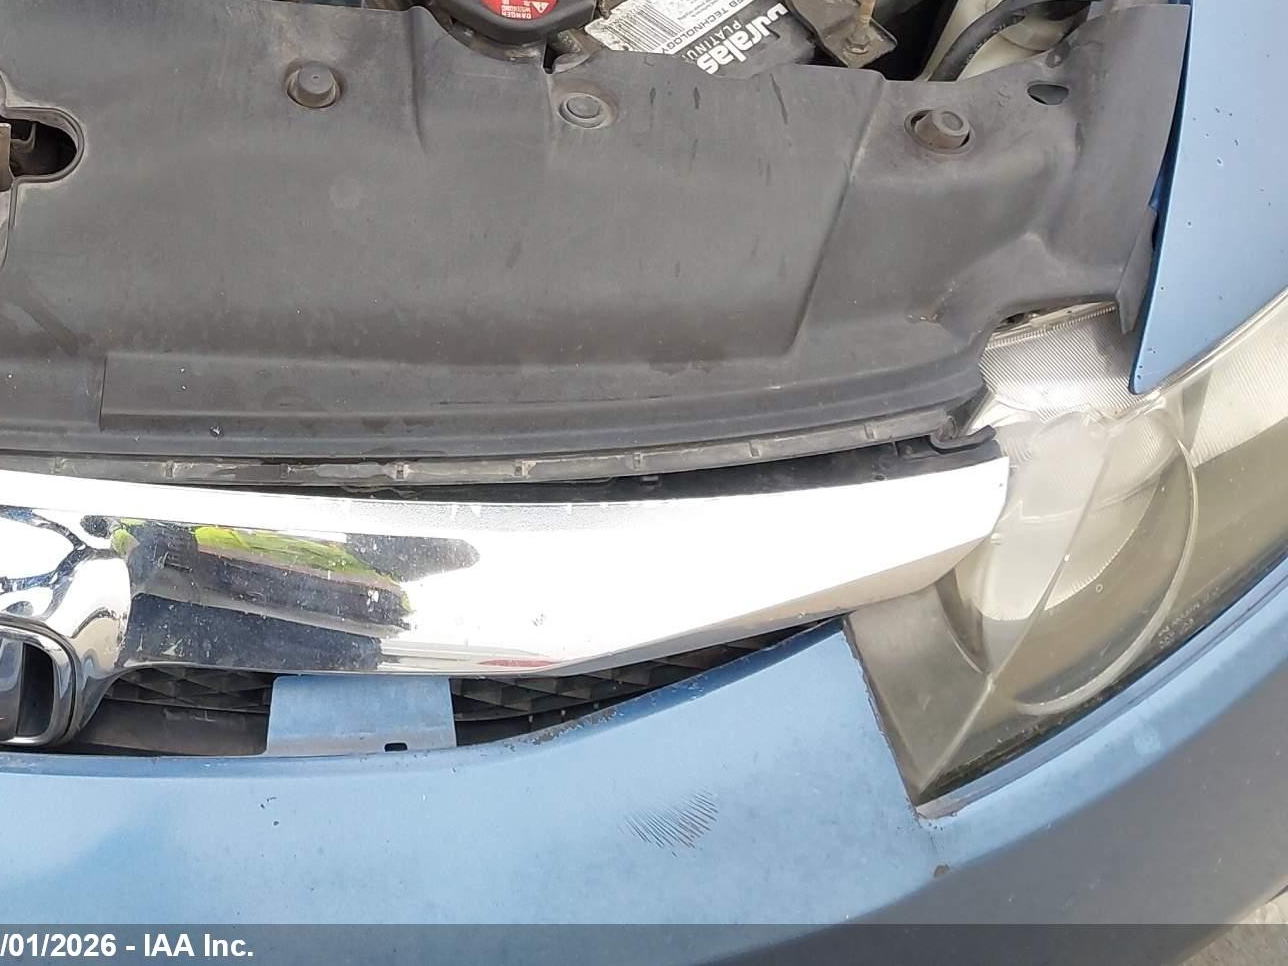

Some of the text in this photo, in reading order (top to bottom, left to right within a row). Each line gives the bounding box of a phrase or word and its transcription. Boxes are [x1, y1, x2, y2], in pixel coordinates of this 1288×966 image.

[501, 11, 532, 19] DANGER
[658, 6, 728, 54] TECHNOLOGY
[682, 20, 743, 62] PLATINU
